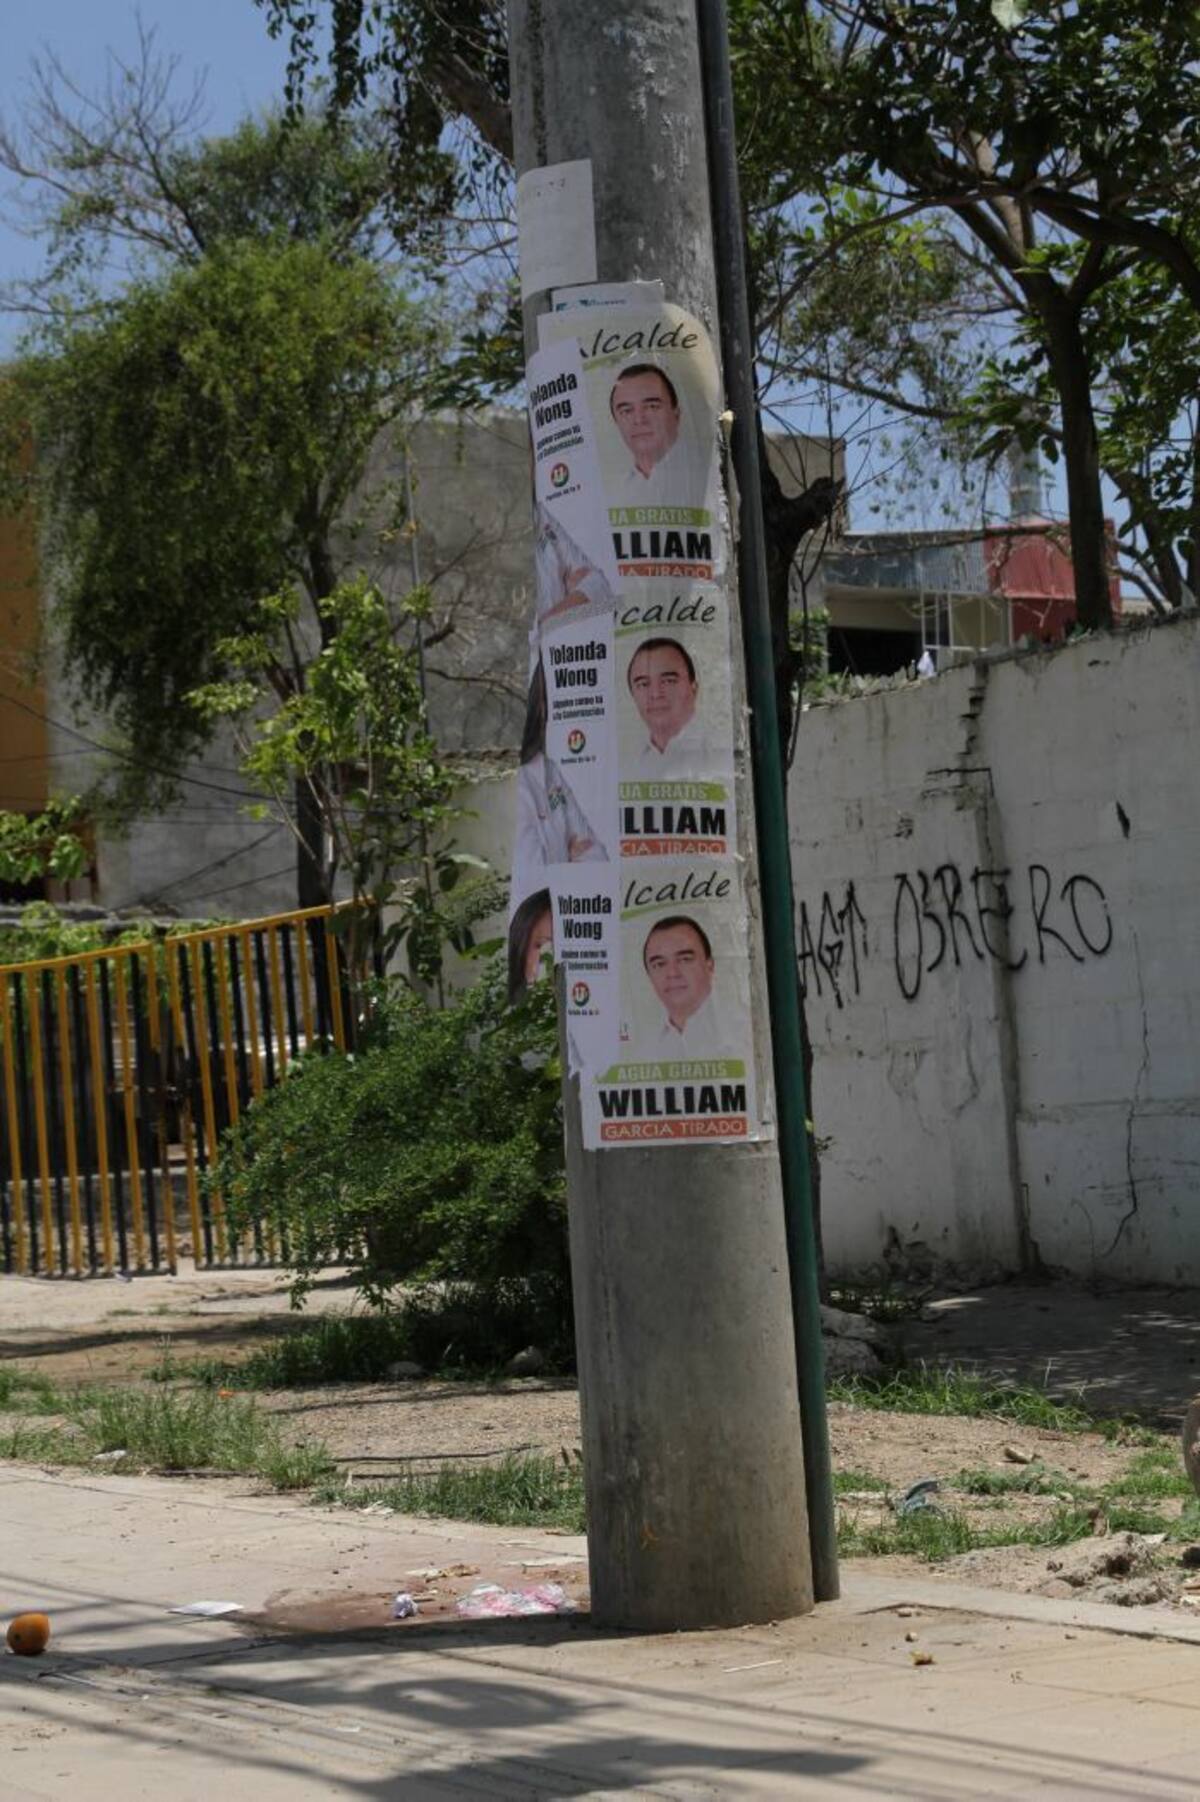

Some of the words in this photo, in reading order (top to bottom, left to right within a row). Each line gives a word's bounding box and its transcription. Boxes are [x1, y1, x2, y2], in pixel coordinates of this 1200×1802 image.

[535, 398, 572, 428] Wong
[635, 508, 692, 523] GRATIS
[612, 531, 712, 560] LLIAM
[613, 596, 715, 626] calde
[549, 641, 607, 665] Yolanda
[554, 668, 597, 688] Wong
[649, 783, 706, 799] GRATIS
[620, 806, 727, 836] LLIAM
[658, 840, 722, 855] TIRADO
[623, 870, 731, 908] lcalde
[558, 894, 612, 916] Yolanda
[563, 918, 603, 941] Wong
[617, 1065, 663, 1081] AGUA
[668, 1061, 727, 1079] GRATIS
[599, 1084, 747, 1118] WILLIAM
[605, 1122, 675, 1139] GARCIA
[679, 1119, 743, 1136] TIRADO
